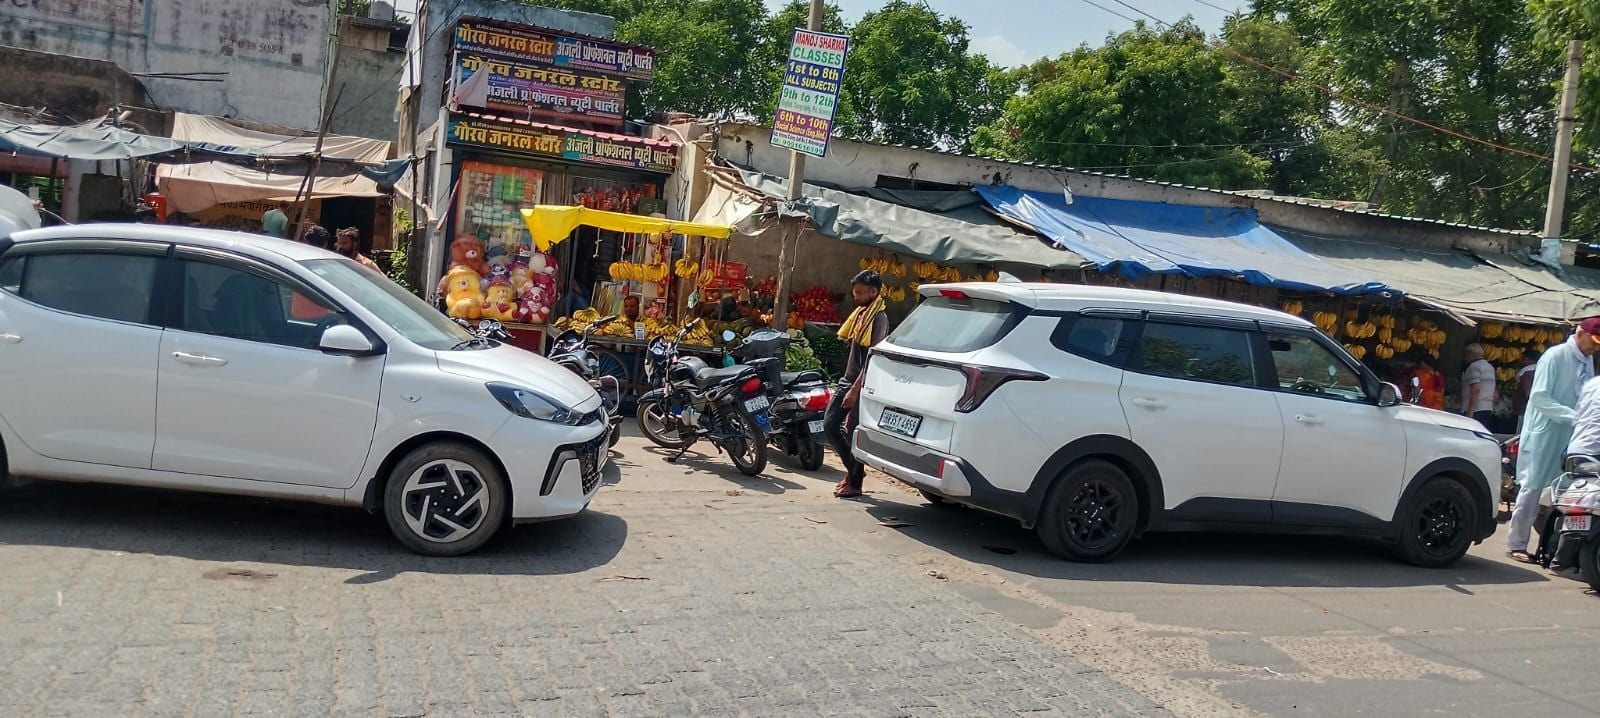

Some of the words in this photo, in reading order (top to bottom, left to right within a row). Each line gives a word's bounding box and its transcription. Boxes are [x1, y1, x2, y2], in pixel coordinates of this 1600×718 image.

[458, 24, 488, 45] गौरव
[488, 32, 528, 51] जनरल
[529, 37, 554, 56] स्टोर
[796, 33, 818, 47] MANOJ
[819, 36, 844, 51] SHARMA
[557, 38, 580, 58] अंजली
[635, 52, 652, 70] पार्लर
[793, 47, 841, 65] CLASSES
[514, 66, 578, 86] जनरल
[580, 75, 621, 92] स्टोर
[790, 62, 806, 74] 1st
[809, 66, 820, 76] to
[822, 68, 838, 80] 8th
[785, 74, 799, 85] (ALL
[801, 77, 837, 93] SUBJECTS)
[595, 99, 619, 113] पार्लर
[784, 88, 797, 100] 9th
[801, 92, 810, 102] to
[814, 94, 833, 108] 12th
[780, 111, 794, 122] 6th
[796, 115, 806, 125] to
[808, 118, 828, 131] 10th
[454, 121, 488, 143] गौरव
[489, 130, 533, 149] जनरल
[566, 134, 594, 154] अंजली
[654, 148, 674, 166] पार्लर
